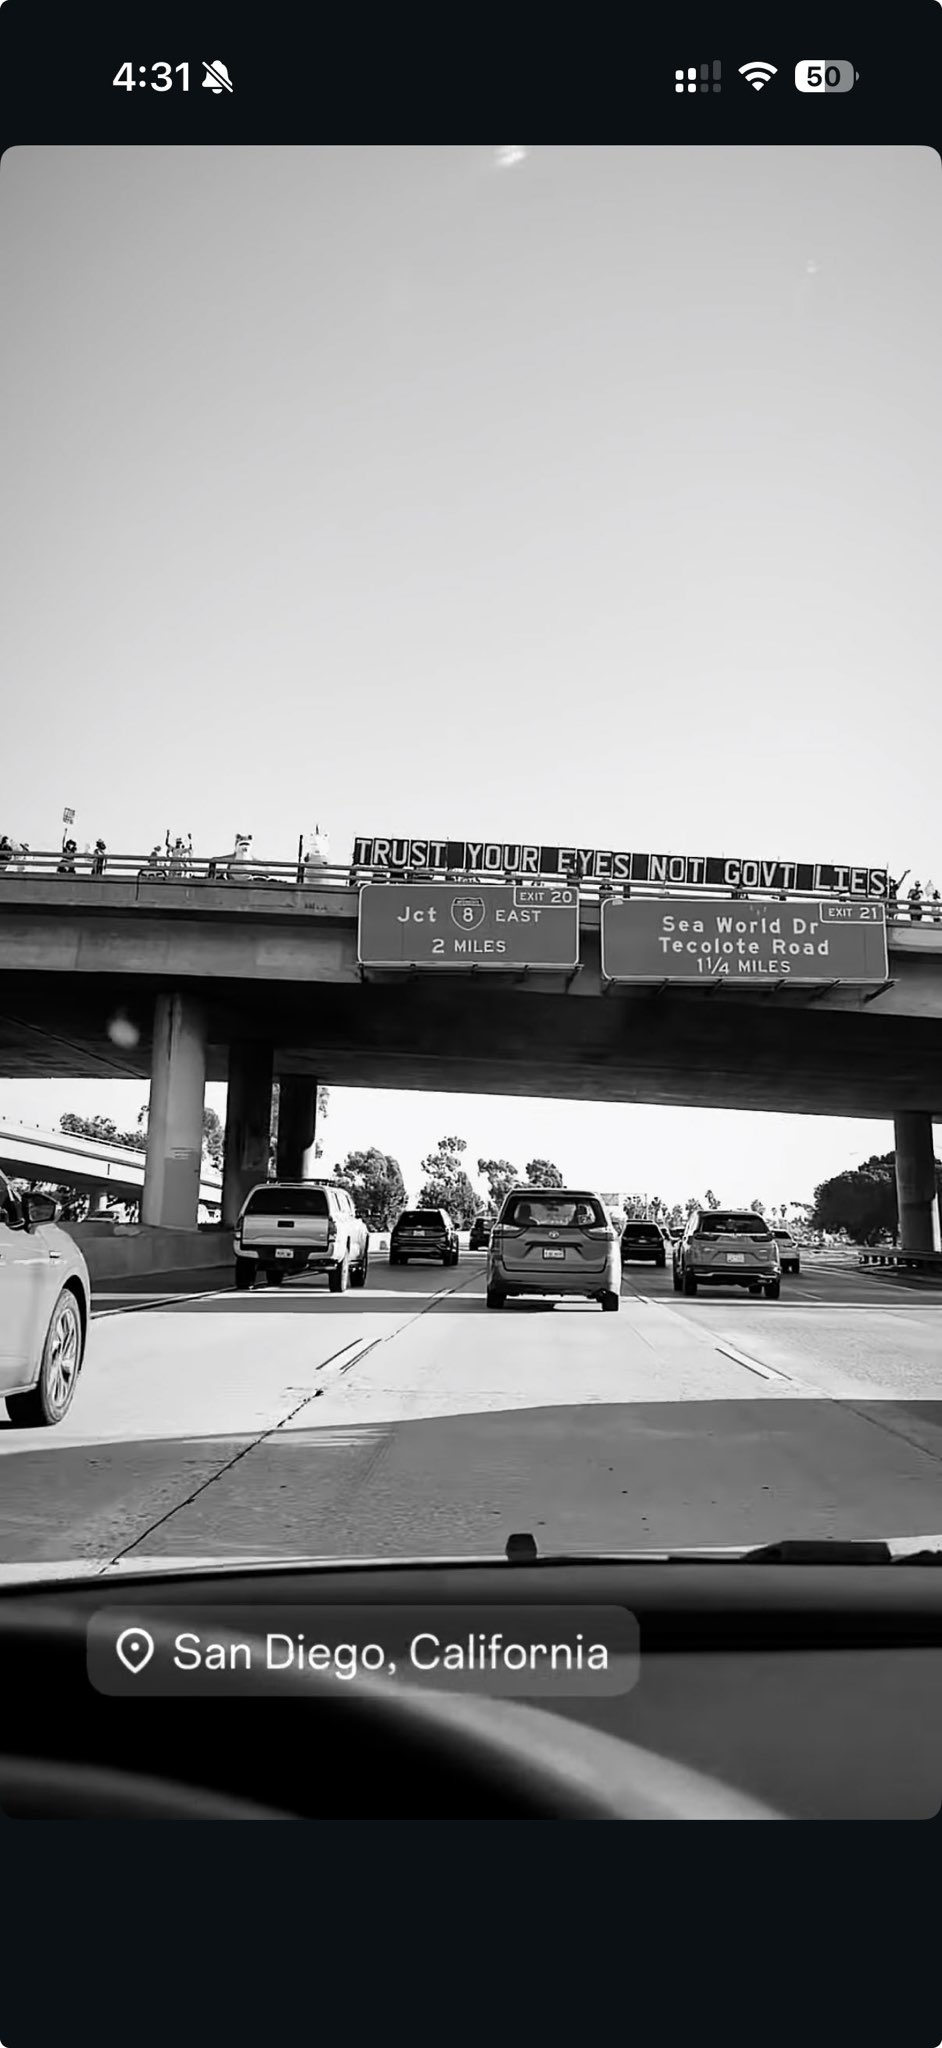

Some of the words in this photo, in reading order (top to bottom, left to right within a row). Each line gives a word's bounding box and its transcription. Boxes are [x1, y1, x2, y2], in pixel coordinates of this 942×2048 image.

[356, 839, 447, 867] TRUST
[467, 843, 538, 872] YOUR
[557, 849, 630, 878] EYES
[650, 856, 704, 883] NOT
[724, 860, 795, 887] GOVT
[813, 866, 887, 896] LIES
[520, 892, 544, 901] EXIT
[551, 891, 573, 904] 20
[397, 906, 437, 923] Jct
[463, 907, 473, 922] 8
[495, 909, 541, 923] EAST
[828, 907, 852, 918] EXIT
[859, 907, 878, 919] 21
[662, 915, 704, 933] Sea
[716, 916, 781, 934] World
[793, 918, 819, 935] Dr
[432, 938, 445, 954] 2
[454, 940, 506, 953] MILES
[658, 936, 760, 955] Tecolote
[773, 938, 829, 956] Road
[738, 960, 791, 974] MILES
